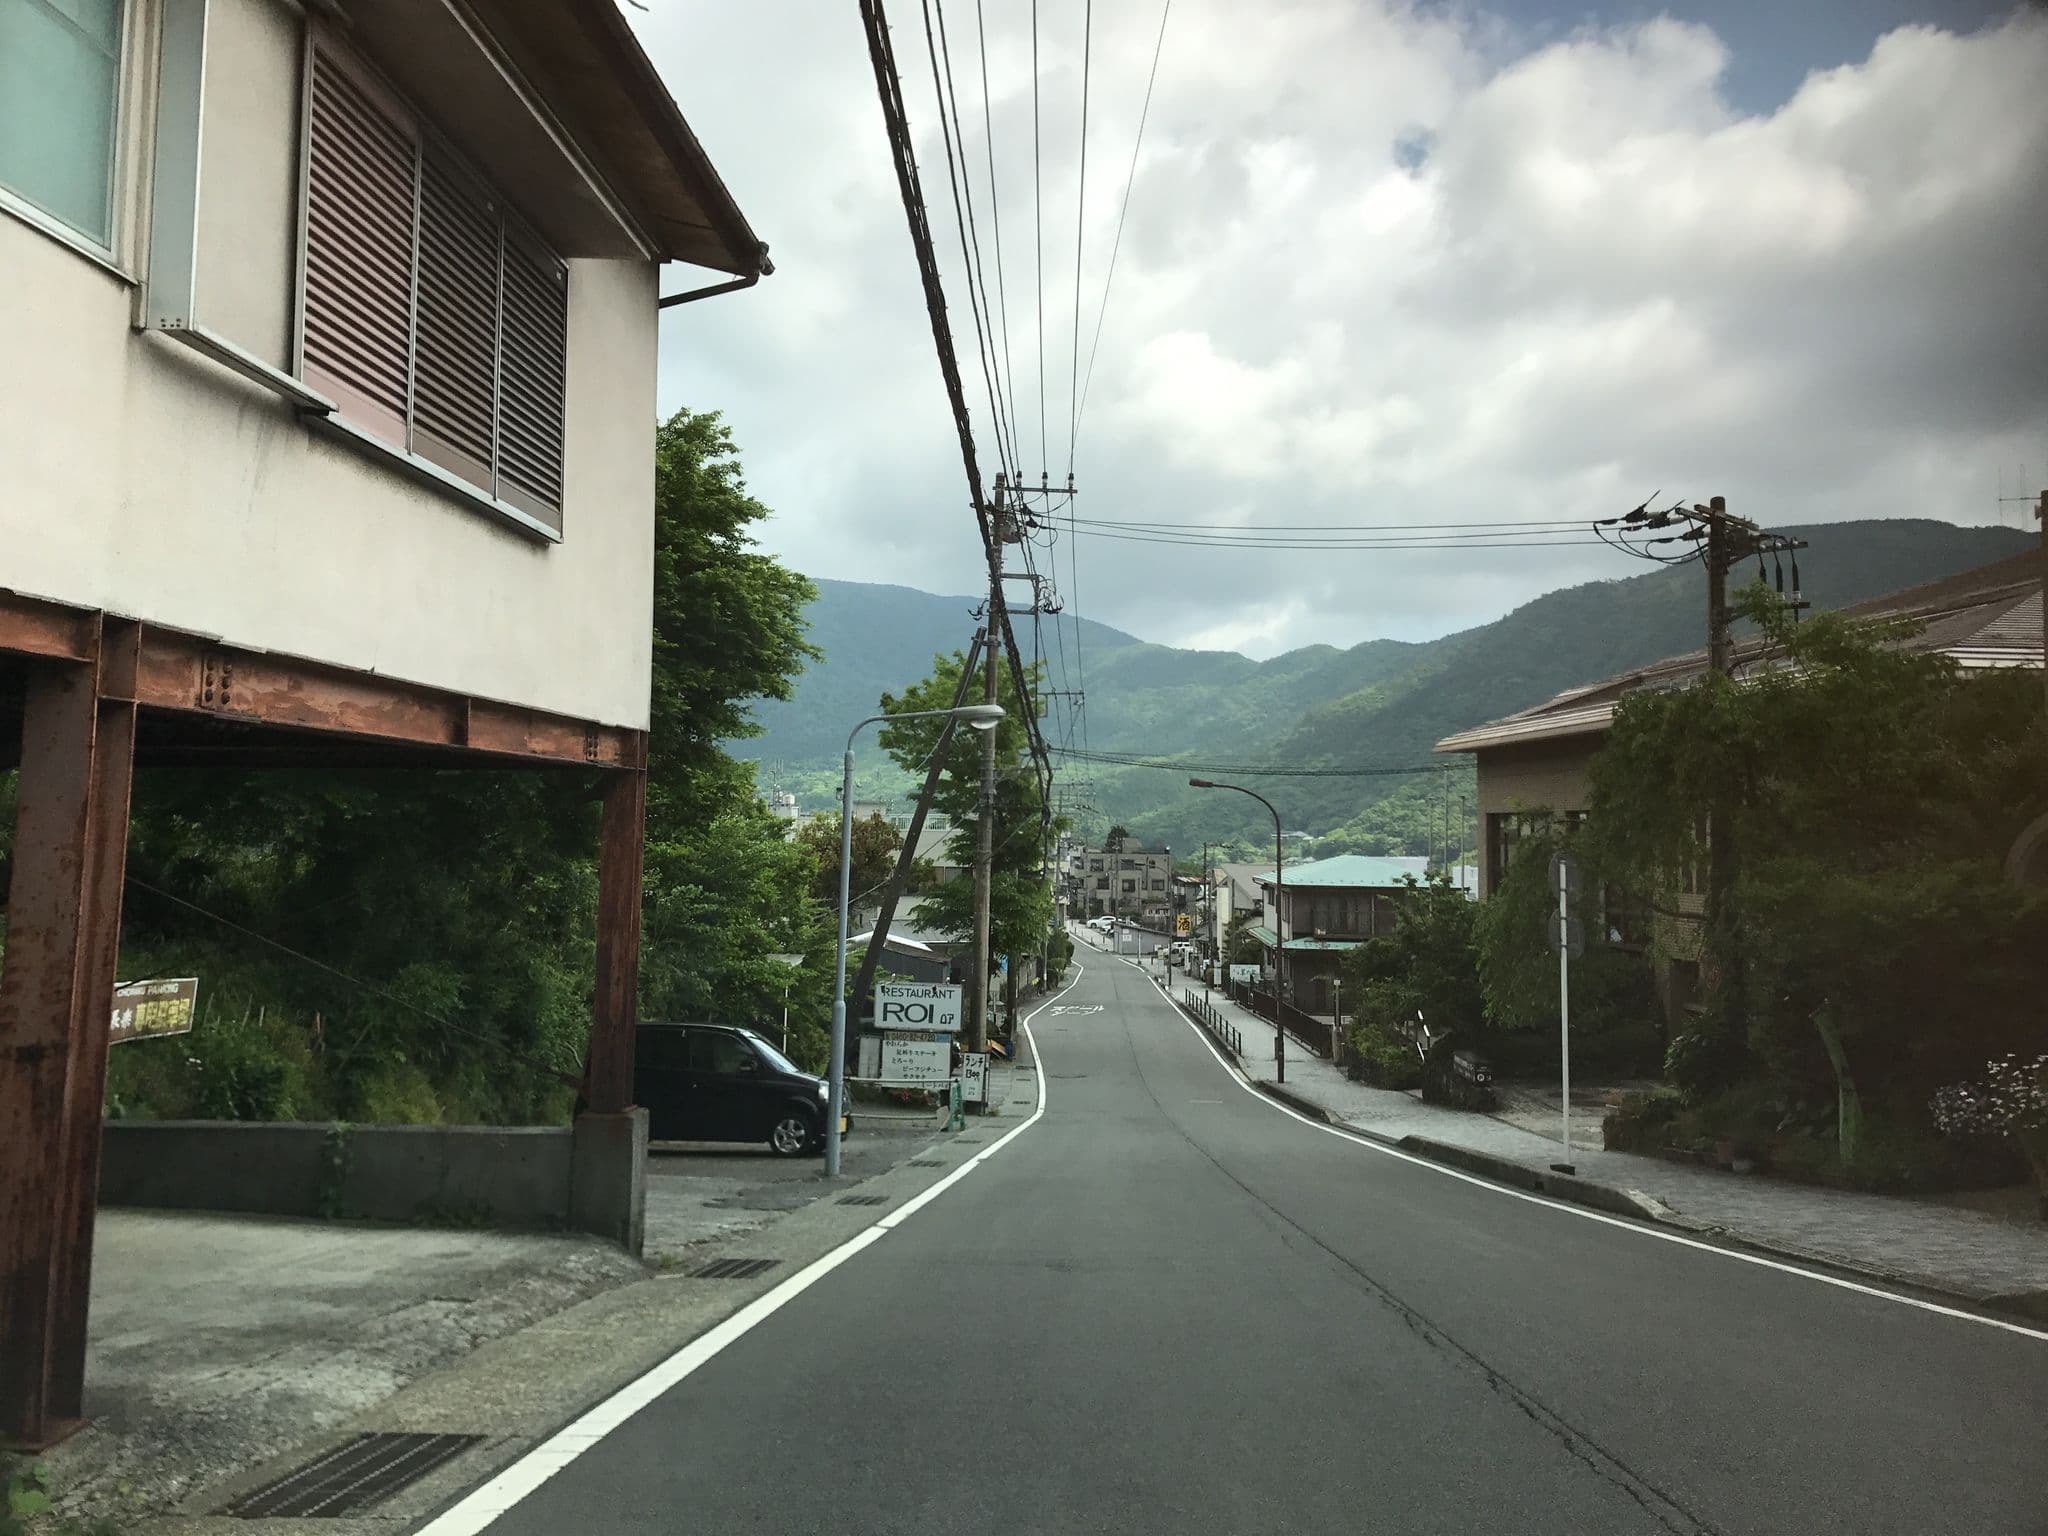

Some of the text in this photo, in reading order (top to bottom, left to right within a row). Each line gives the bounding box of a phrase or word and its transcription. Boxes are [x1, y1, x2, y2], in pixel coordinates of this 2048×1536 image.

[1178, 916, 1190, 931] 酒
[883, 986, 955, 999] RESTAURANT
[883, 1002, 955, 1025] ROI ロア
[965, 1055, 983, 1068] ランチ
